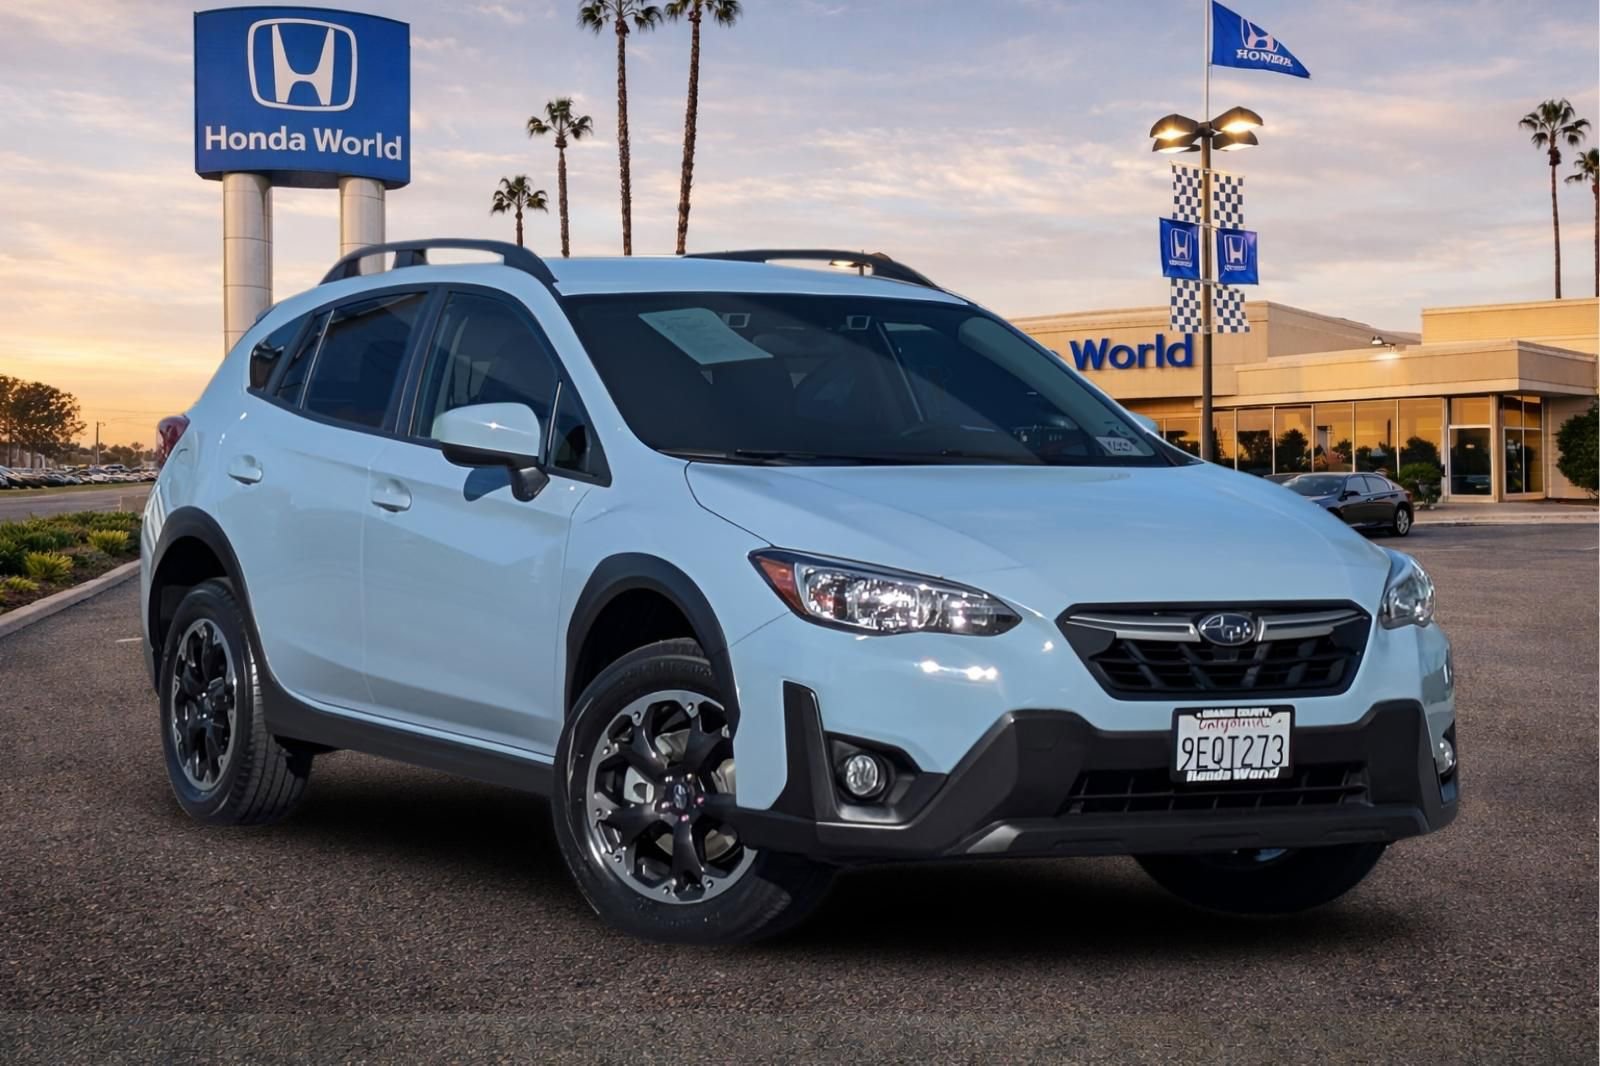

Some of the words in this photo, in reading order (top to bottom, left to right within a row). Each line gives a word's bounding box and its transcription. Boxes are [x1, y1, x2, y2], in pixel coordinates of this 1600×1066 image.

[205, 125, 306, 151] Honda
[312, 127, 402, 161] World
[1069, 333, 1193, 371] World
[1181, 735, 1284, 769] 9EQT273
